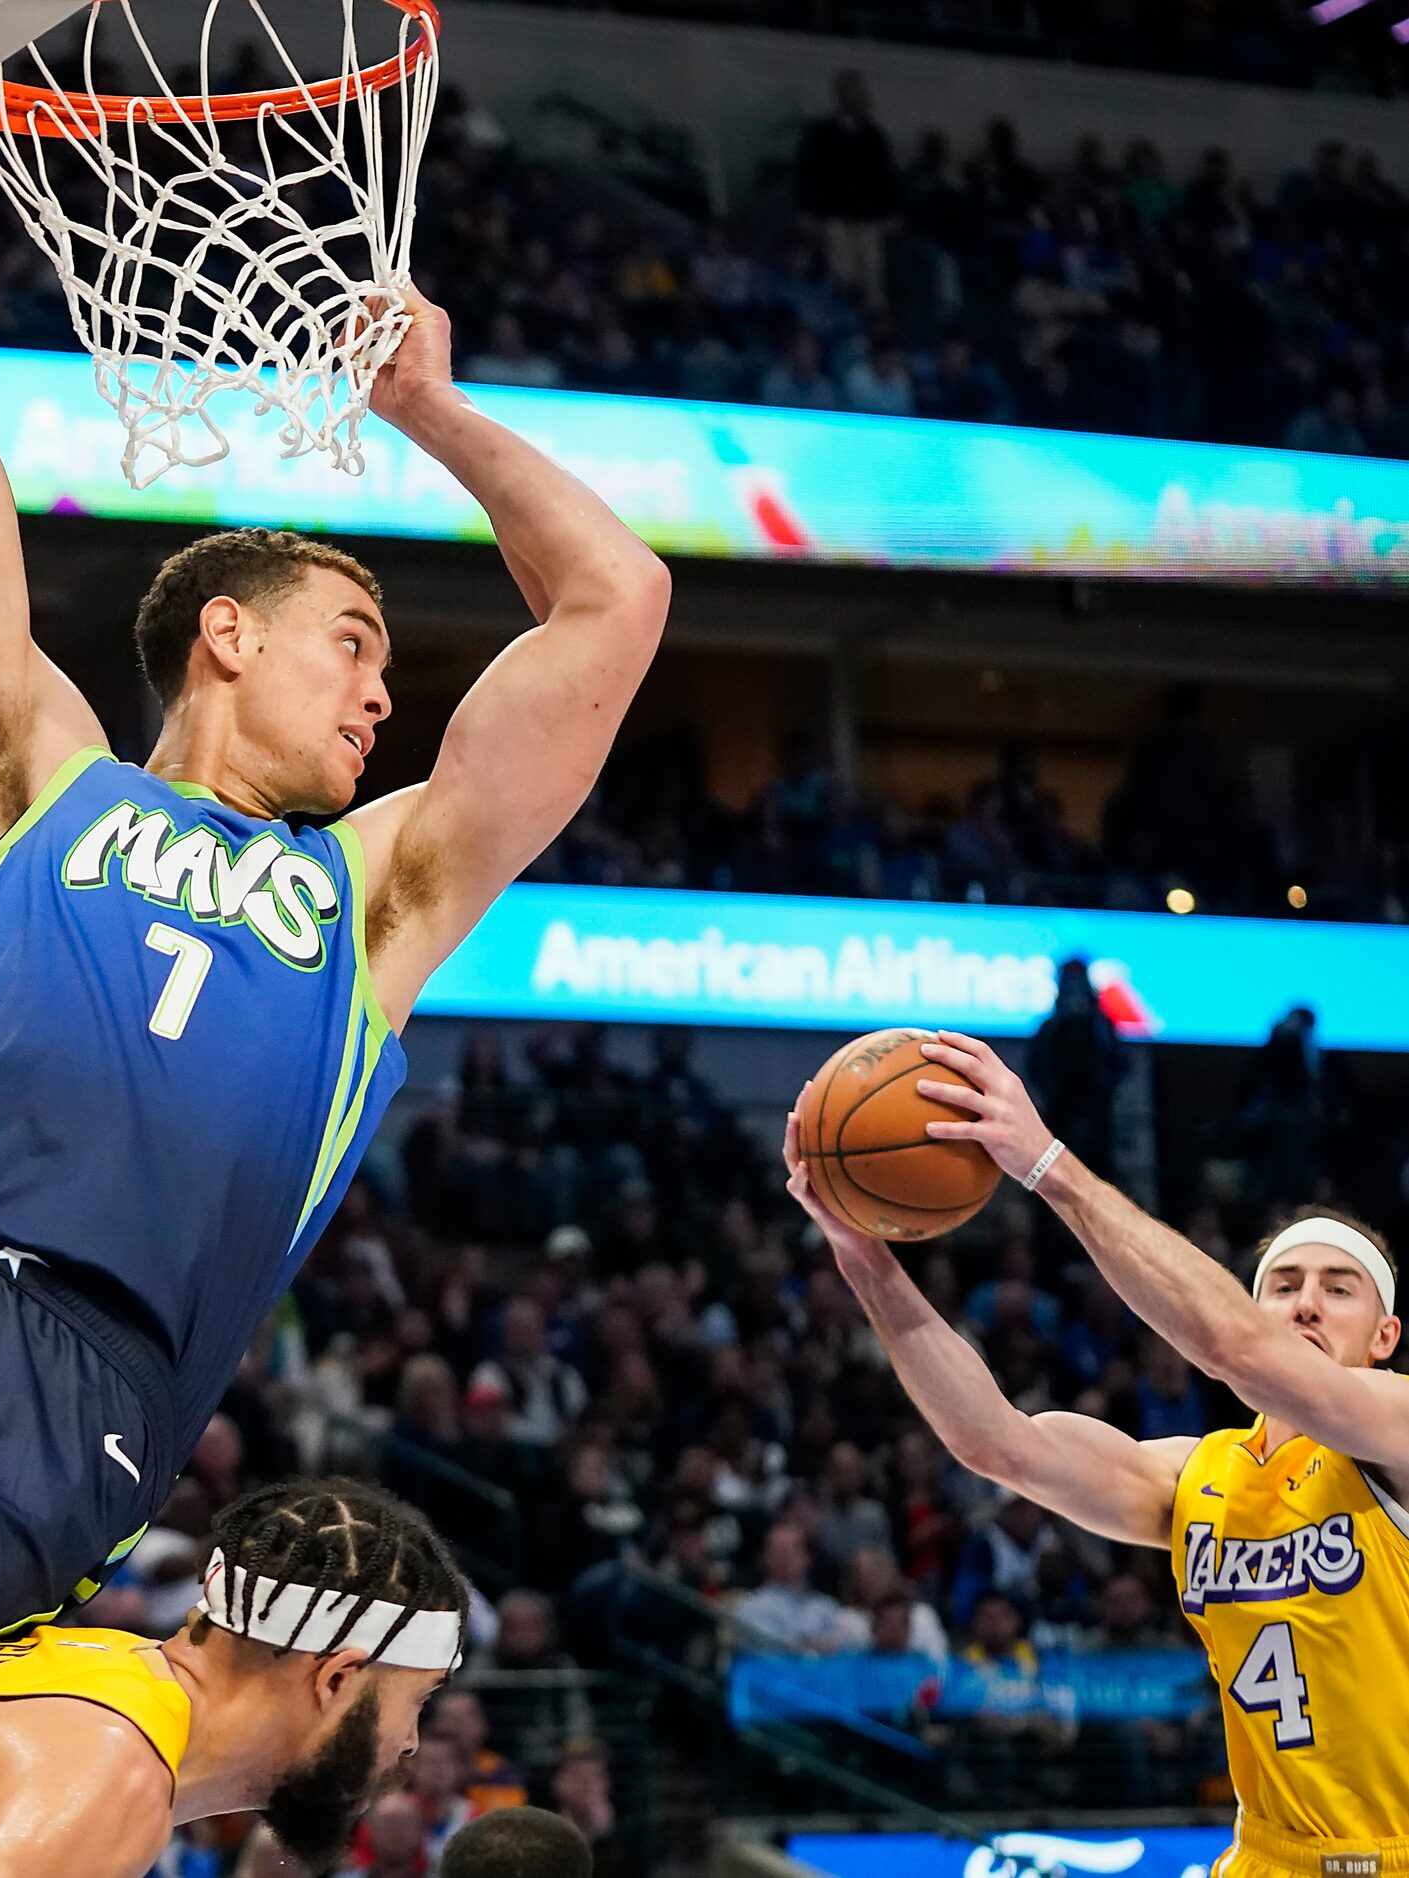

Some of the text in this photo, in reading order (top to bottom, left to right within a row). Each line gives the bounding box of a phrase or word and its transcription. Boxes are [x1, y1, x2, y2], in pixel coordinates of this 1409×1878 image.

[61, 798, 342, 973] MAVS
[144, 921, 214, 1041] 7
[530, 919, 1057, 1013] American Airlines
[1182, 1512, 1365, 1616] LAKERS
[1228, 1621, 1316, 1752] 4
